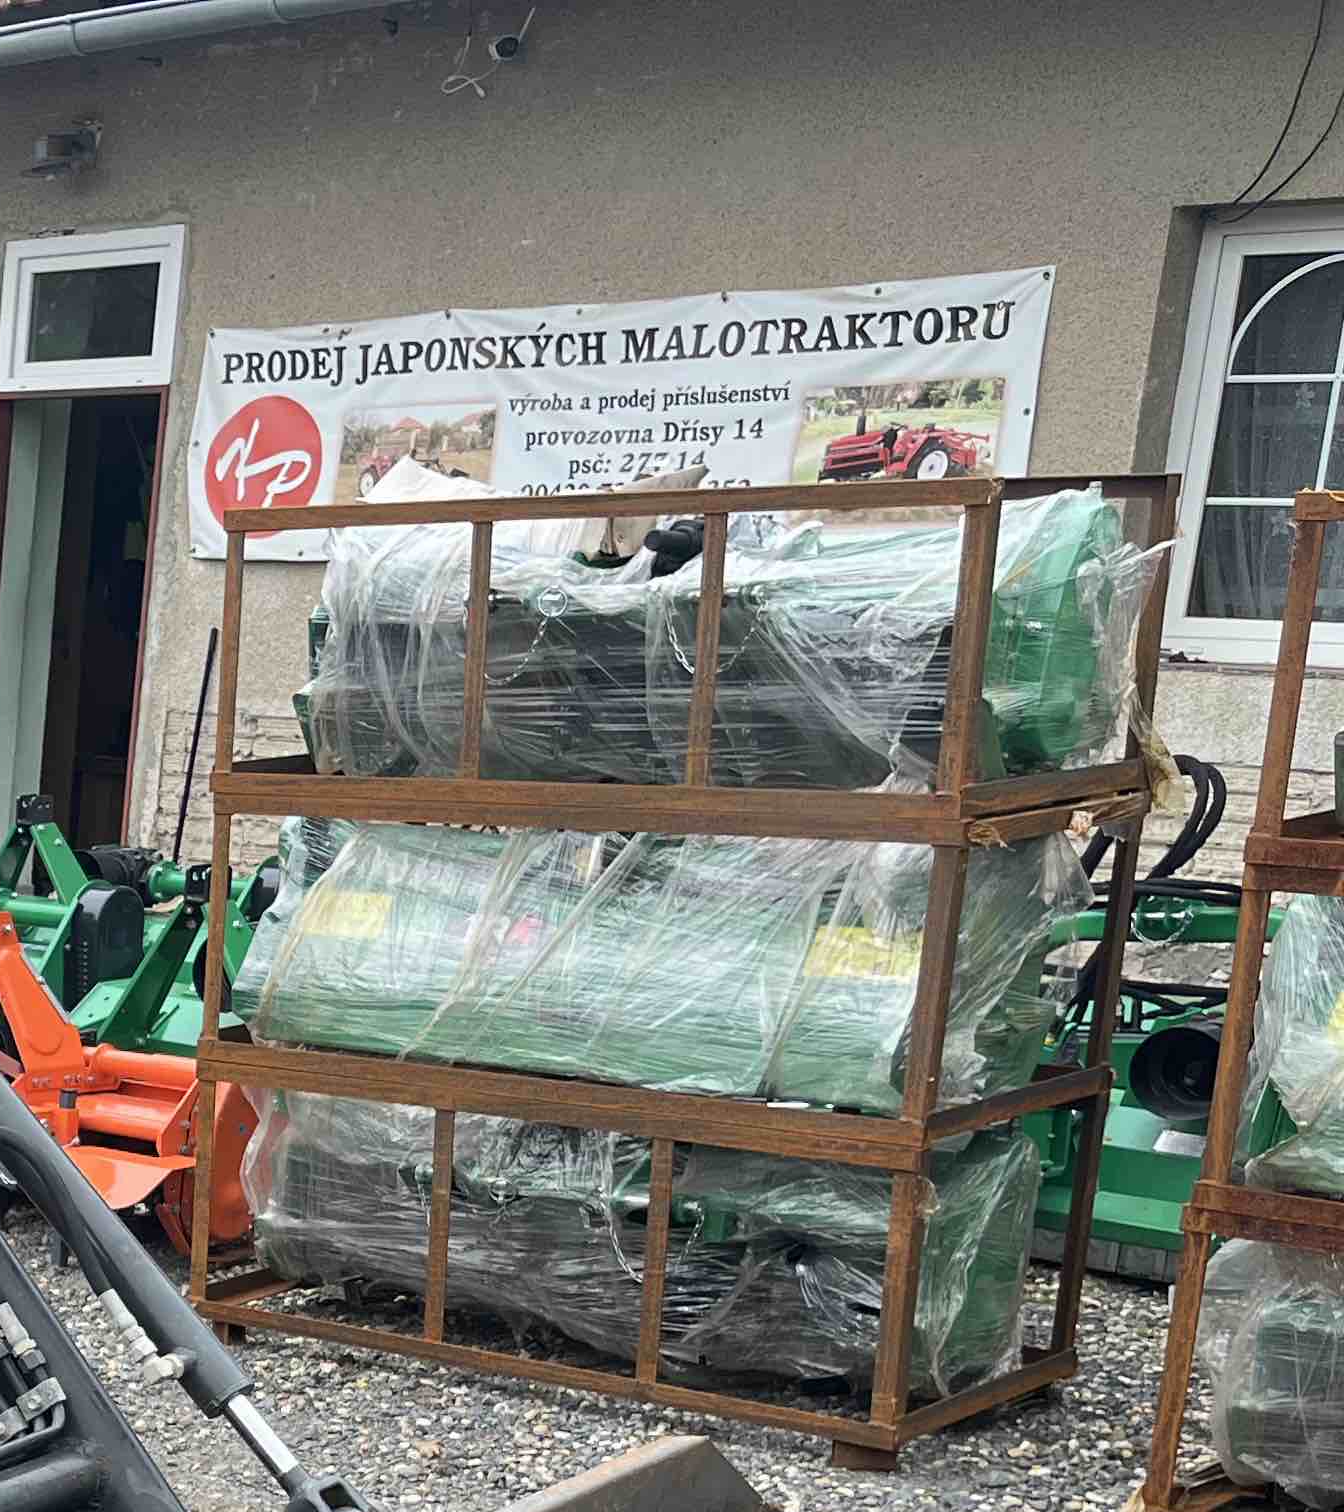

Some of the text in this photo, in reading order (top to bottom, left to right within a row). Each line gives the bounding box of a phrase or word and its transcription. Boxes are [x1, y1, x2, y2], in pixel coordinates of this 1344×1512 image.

[221, 300, 1016, 387] PRODEJ JAPONSKÝCH MALOTRAKTORŮ
[509, 379, 792, 416] výroba a prodej příslušenství
[525, 417, 764, 450] provozovna Dřísy 14
[568, 452, 612, 479] psč:
